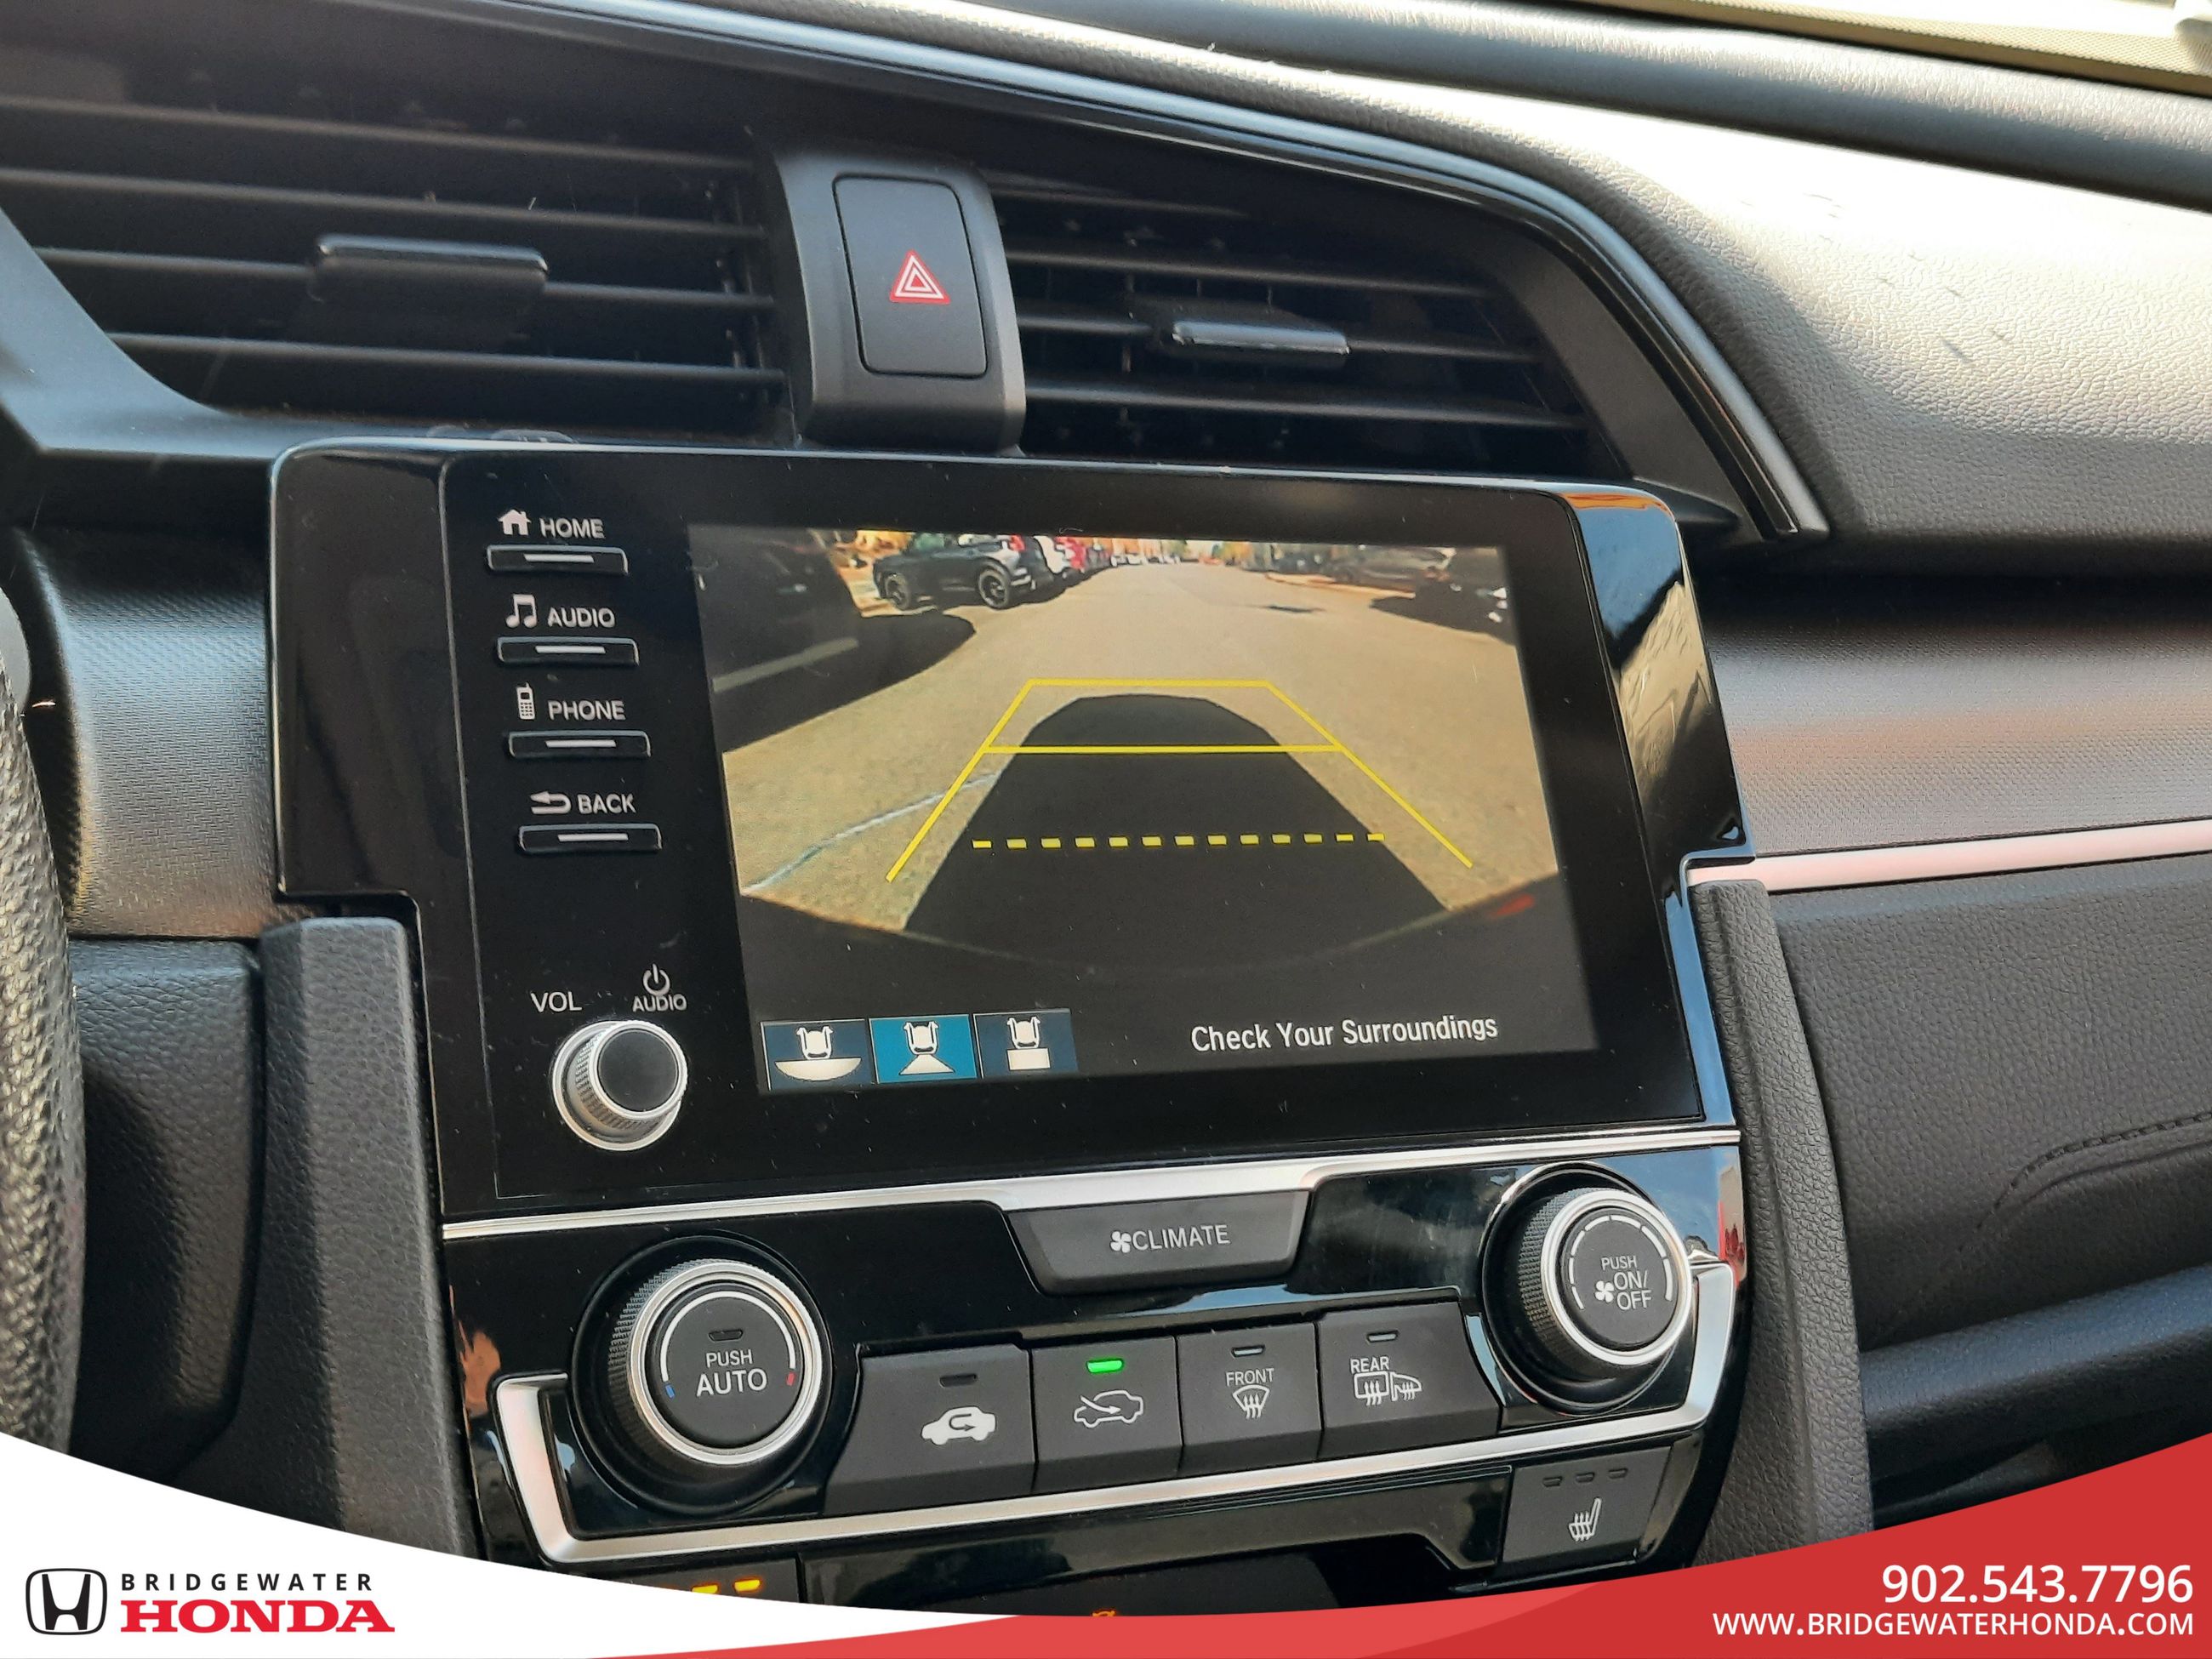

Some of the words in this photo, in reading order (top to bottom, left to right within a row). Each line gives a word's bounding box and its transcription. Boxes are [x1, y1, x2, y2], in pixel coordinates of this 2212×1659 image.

[539, 518, 605, 539] HOME
[547, 607, 616, 628] AUDIO
[548, 700, 626, 721] PHONE
[578, 793, 636, 814] BACK
[530, 991, 582, 1012] VOL
[632, 994, 687, 1012] AUDIO
[1191, 1024, 1271, 1052] Check
[1276, 1023, 1334, 1047] Your
[1342, 1015, 1498, 1045] Surroundings
[1132, 1224, 1230, 1251] CLIMATE
[1601, 1255, 1638, 1270] PUSH
[1614, 1270, 1648, 1291] ON/
[1617, 1290, 1651, 1310] OFF
[706, 1348, 753, 1368] PUSH
[1350, 1356, 1389, 1373] REAR
[696, 1368, 767, 1397] AUTO
[1226, 1368, 1274, 1387] FRONT
